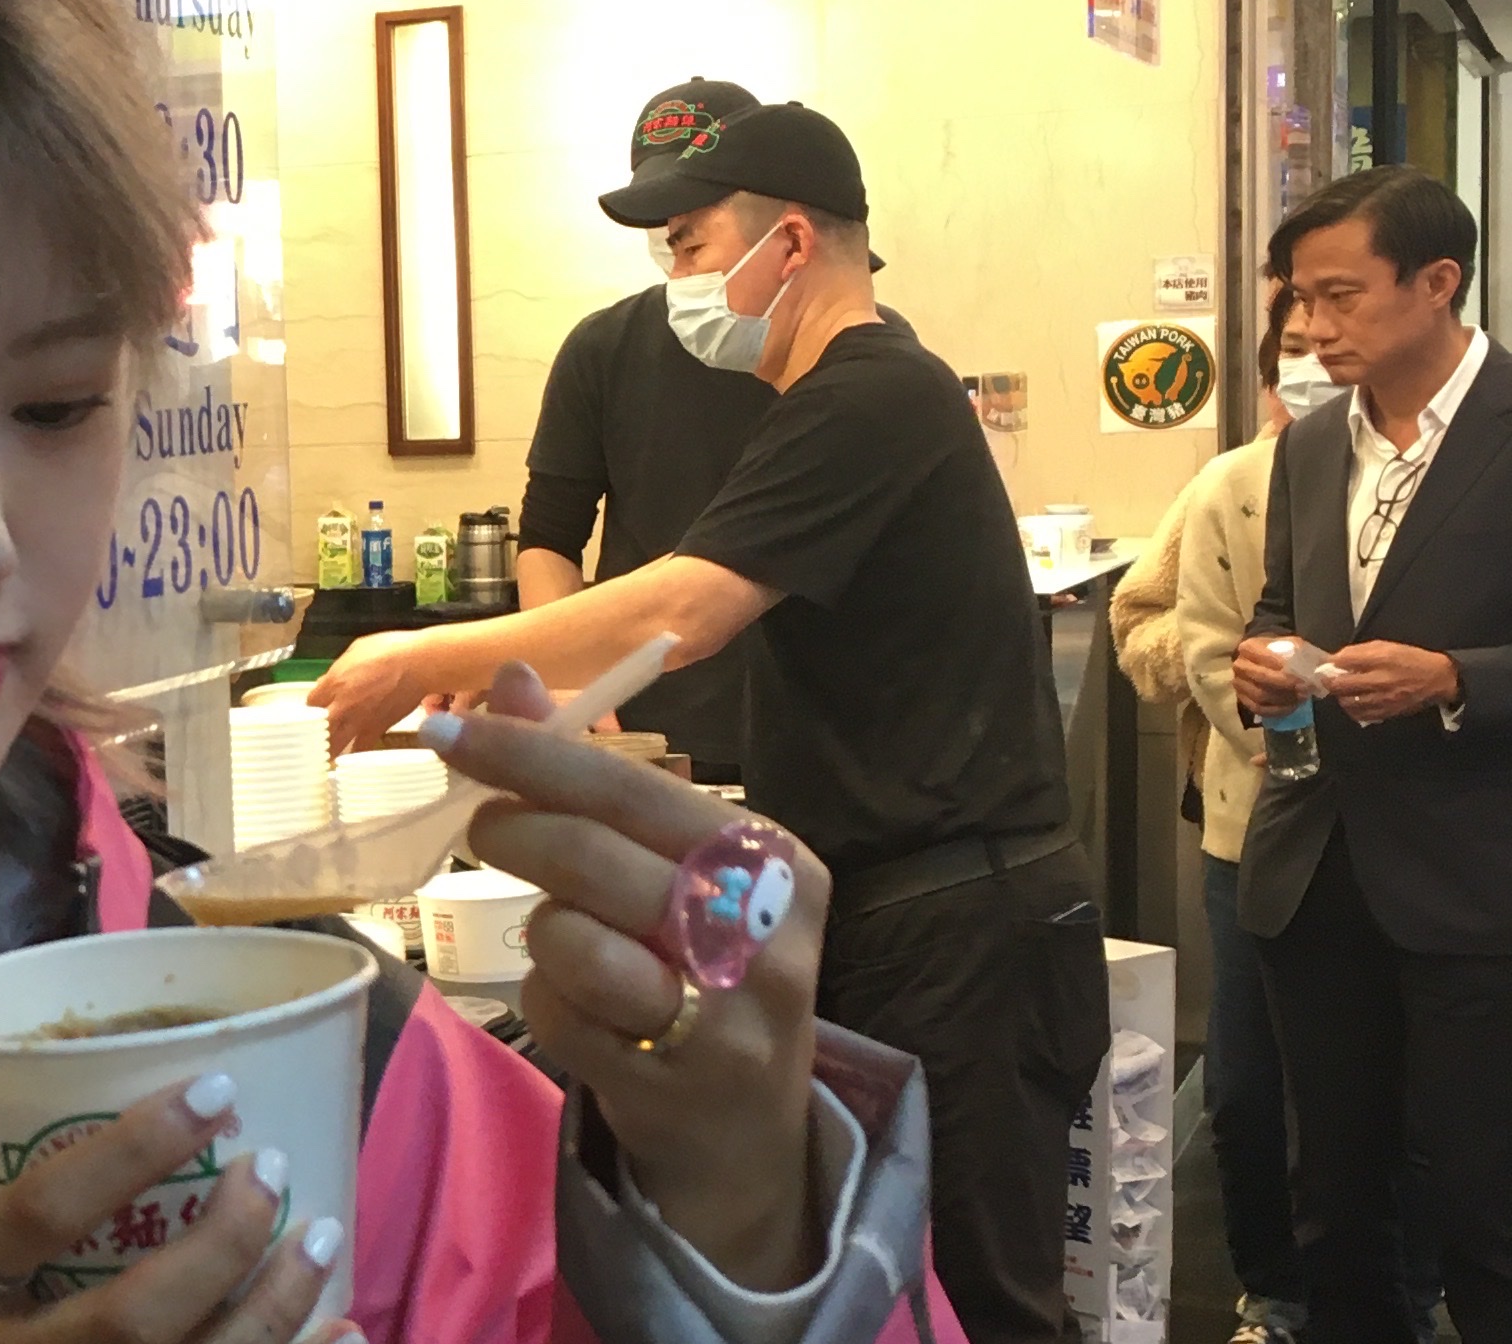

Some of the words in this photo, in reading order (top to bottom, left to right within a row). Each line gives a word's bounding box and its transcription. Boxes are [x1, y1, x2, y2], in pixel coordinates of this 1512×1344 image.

[1113, 328, 1158, 361] TAIWAN
[1159, 328, 1196, 353] PORK
[133, 386, 249, 469] Sunday
